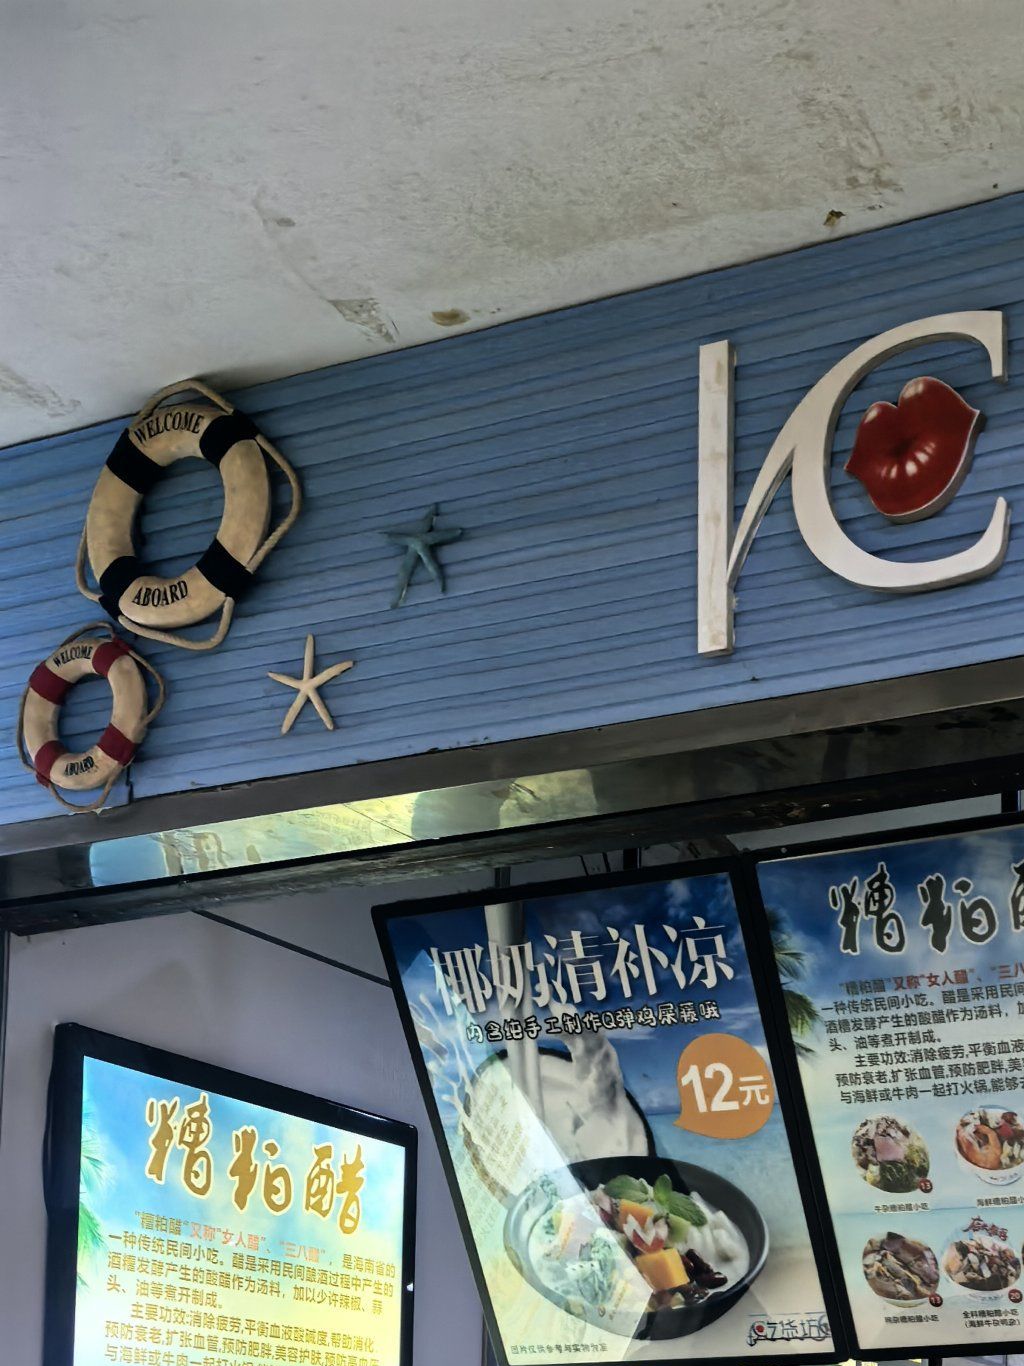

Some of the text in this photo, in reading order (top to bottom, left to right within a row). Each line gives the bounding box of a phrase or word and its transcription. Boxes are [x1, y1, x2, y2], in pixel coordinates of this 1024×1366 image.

[134, 412, 205, 445] WELCOME
[132, 579, 189, 607] ABOARD
[53, 644, 93, 668] WELCOME
[63, 756, 95, 777] ABOARD
[430, 915, 735, 1016] 椰奶清补凉
[680, 1062, 770, 1113] 12元
[146, 1093, 367, 1234] 糟粕醋
